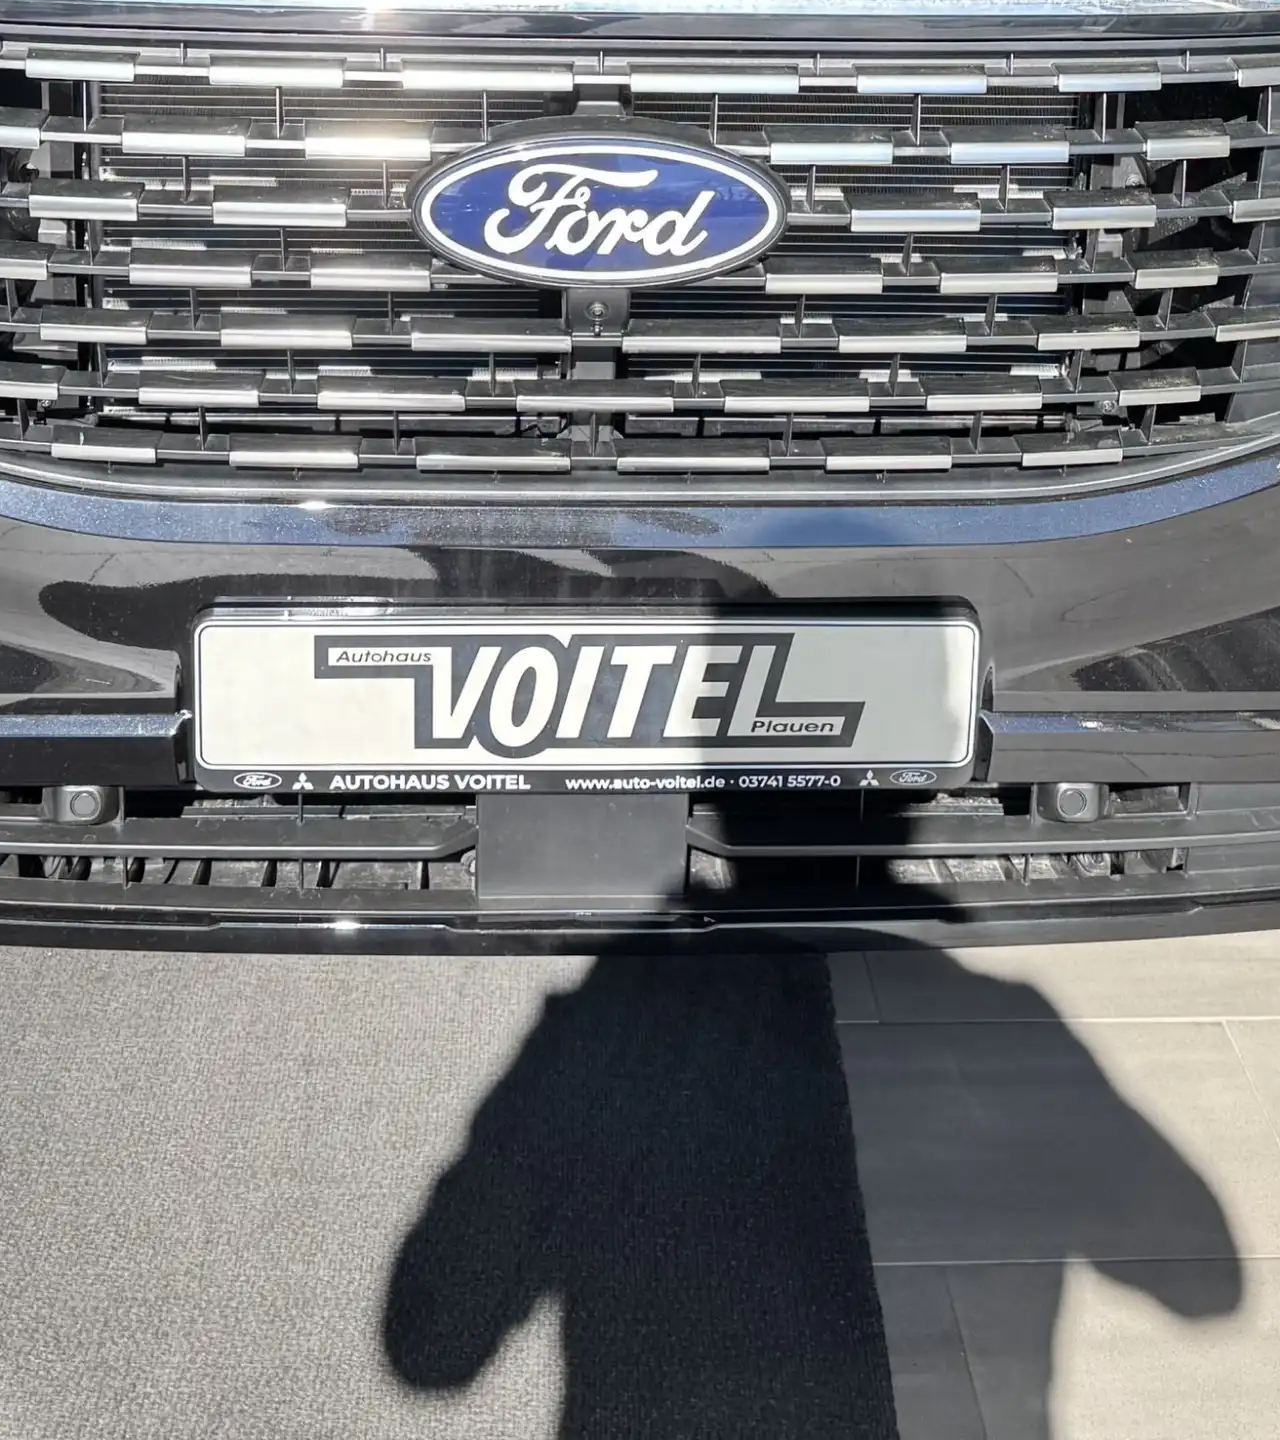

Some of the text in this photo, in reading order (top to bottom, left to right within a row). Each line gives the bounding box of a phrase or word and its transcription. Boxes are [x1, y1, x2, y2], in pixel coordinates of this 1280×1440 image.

[483, 163, 716, 257] Ford
[336, 651, 432, 663] Autohaus
[432, 645, 776, 748] VOITEL
[750, 719, 835, 734] Plauen
[329, 774, 531, 790] AUTOHAUS VOITEL
[565, 772, 841, 791] www.auto-voitel.de 03741 5577-0
[897, 769, 931, 784] Ford
